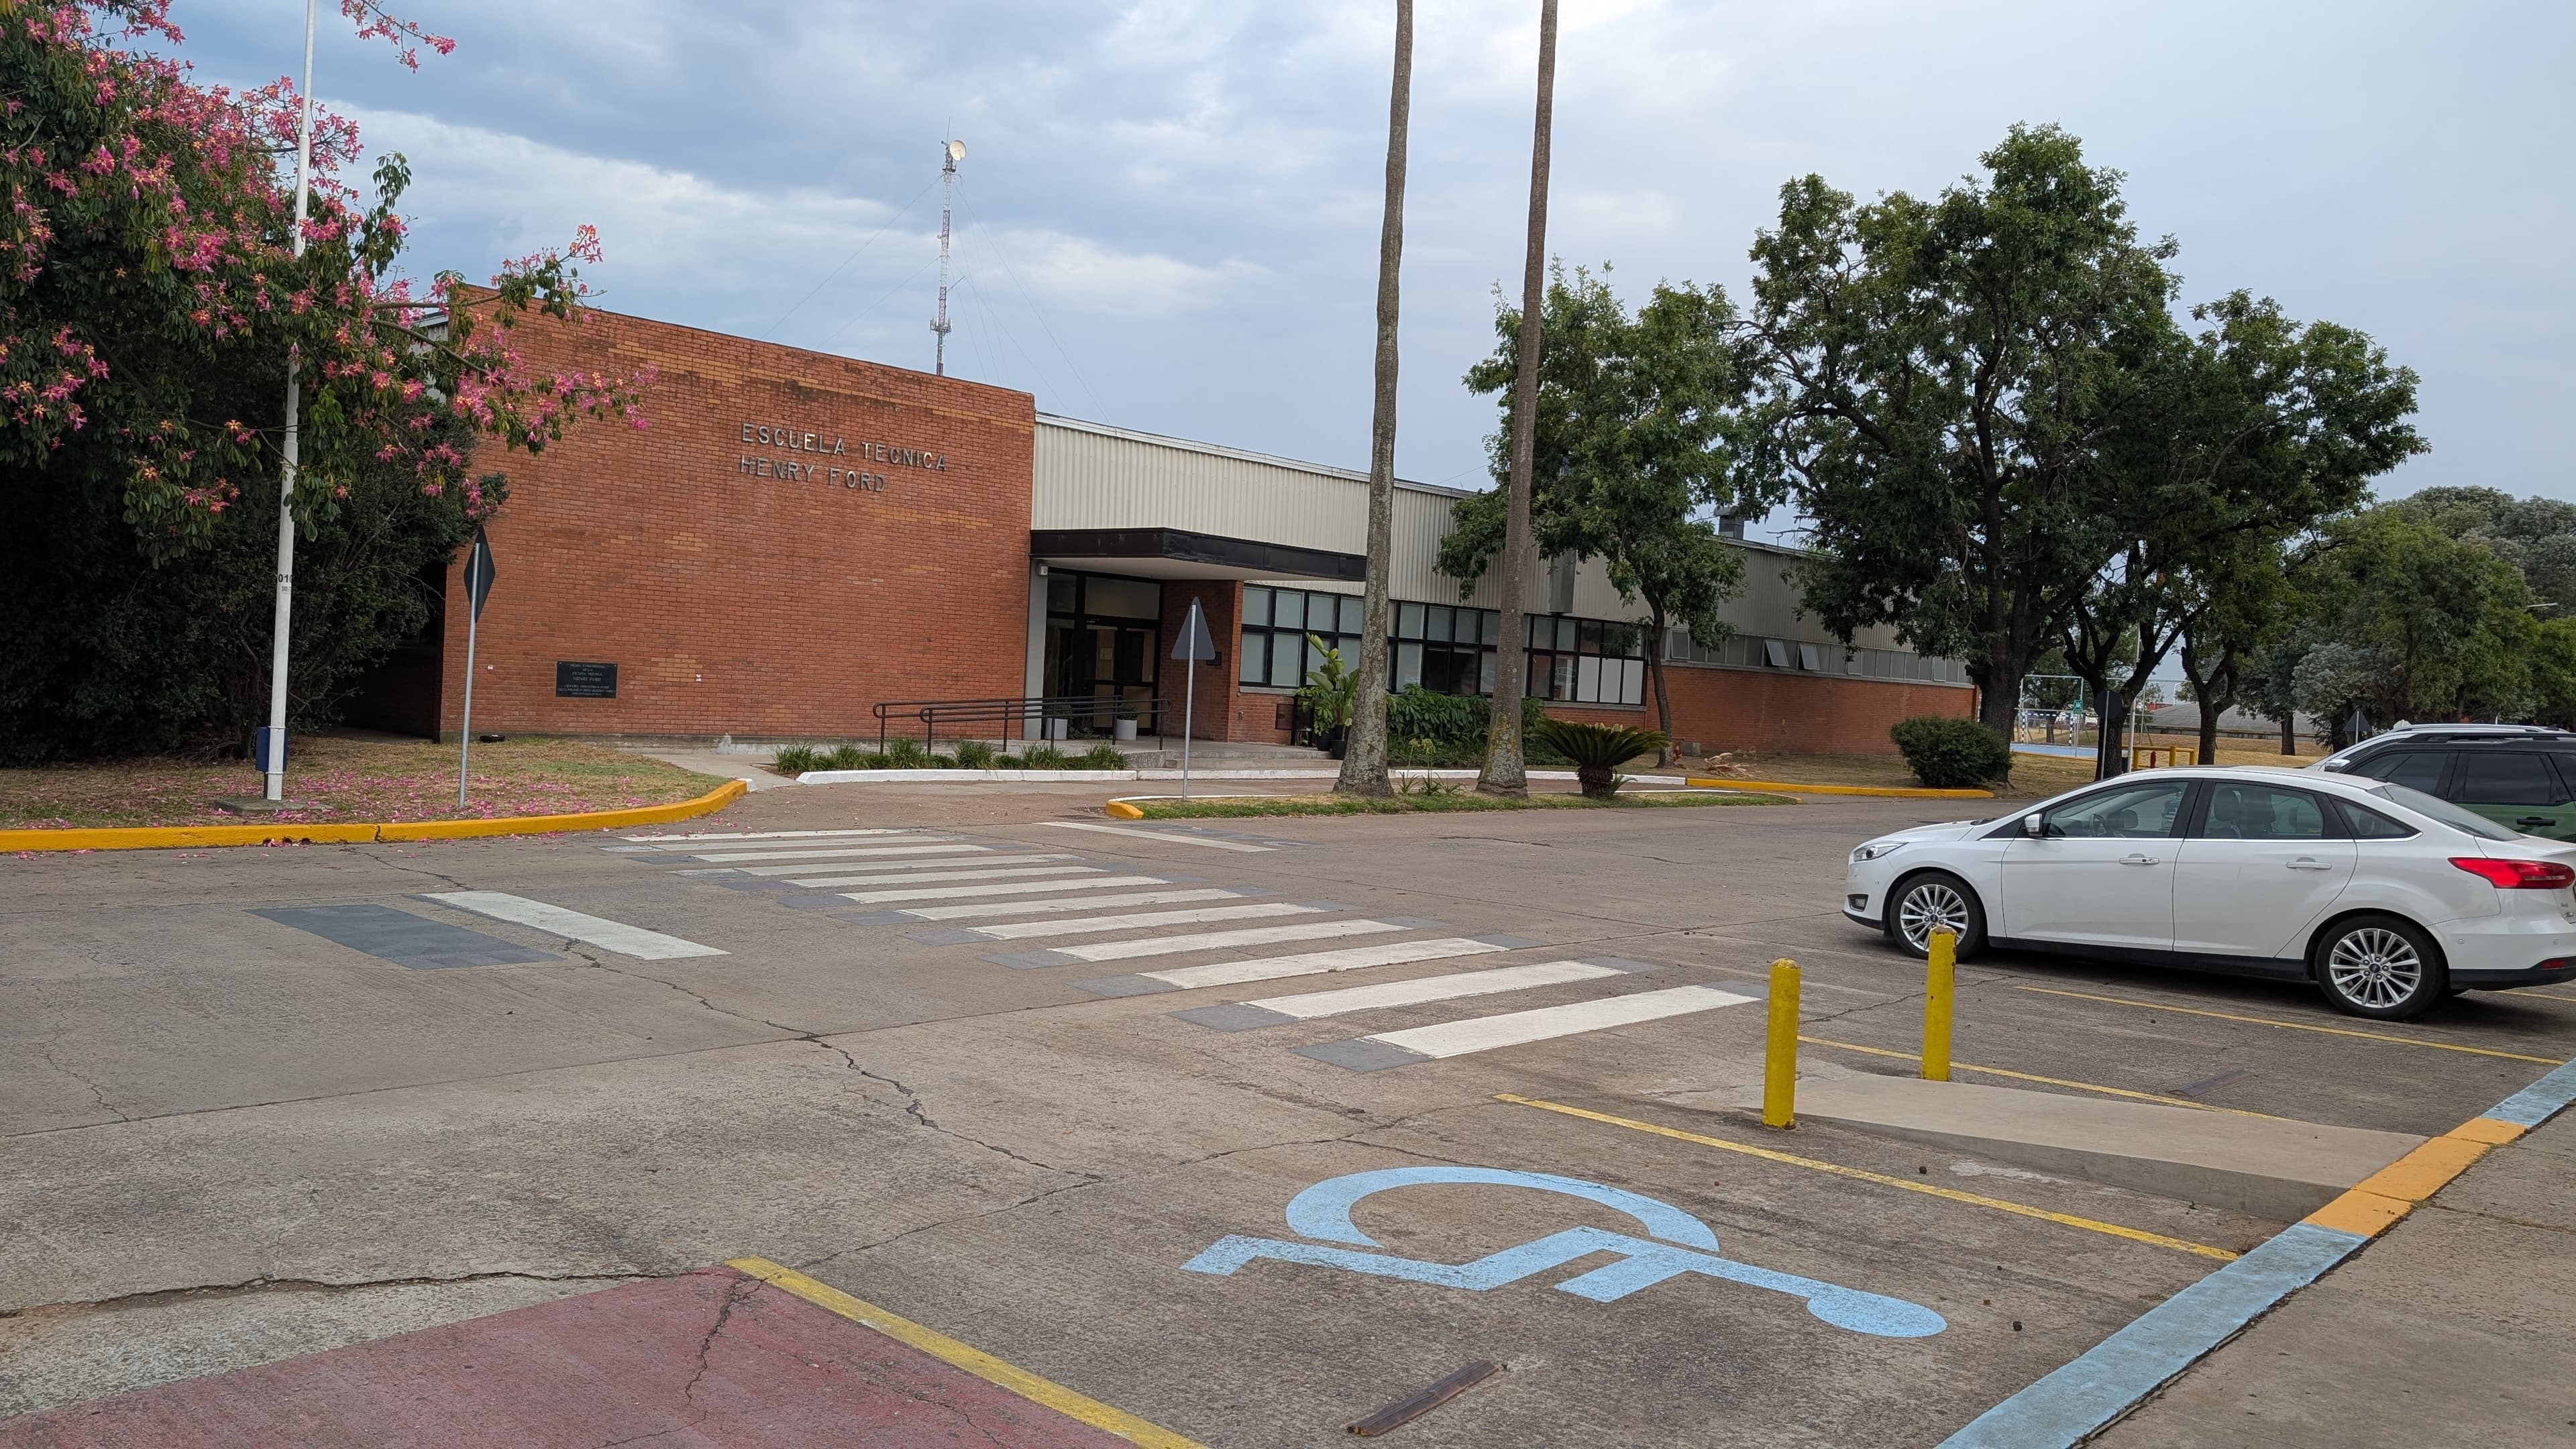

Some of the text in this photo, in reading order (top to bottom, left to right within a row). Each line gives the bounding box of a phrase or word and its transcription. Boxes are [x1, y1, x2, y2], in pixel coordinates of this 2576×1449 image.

[741, 423, 947, 472] ESCUELA TECNICA
[740, 454, 886, 493] HENRY FORD
